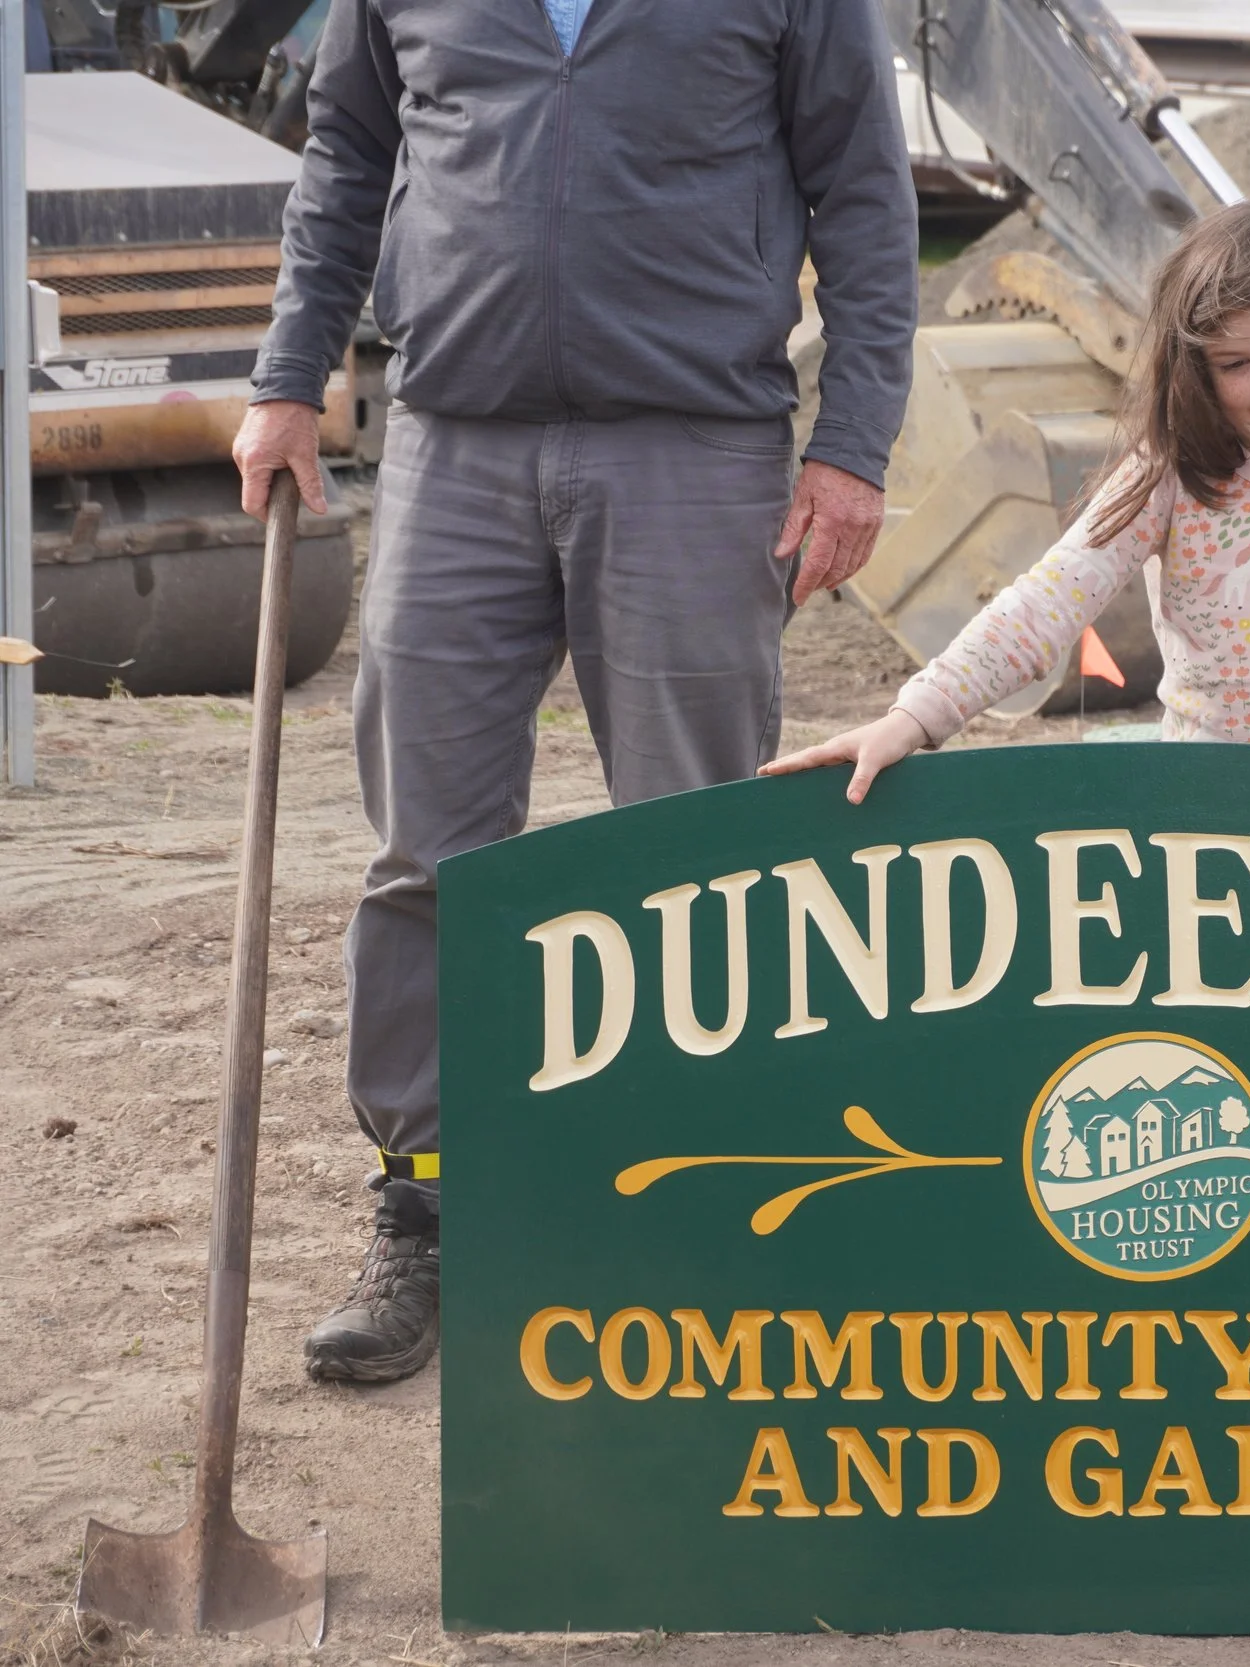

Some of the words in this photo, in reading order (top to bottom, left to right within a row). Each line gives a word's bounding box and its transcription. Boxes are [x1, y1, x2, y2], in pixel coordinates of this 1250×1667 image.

[42, 423, 103, 452] 2898
[1071, 1200, 1242, 1240] HOUSING
[1116, 1238, 1195, 1261] TRUST
[721, 1426, 1002, 1519] AND
